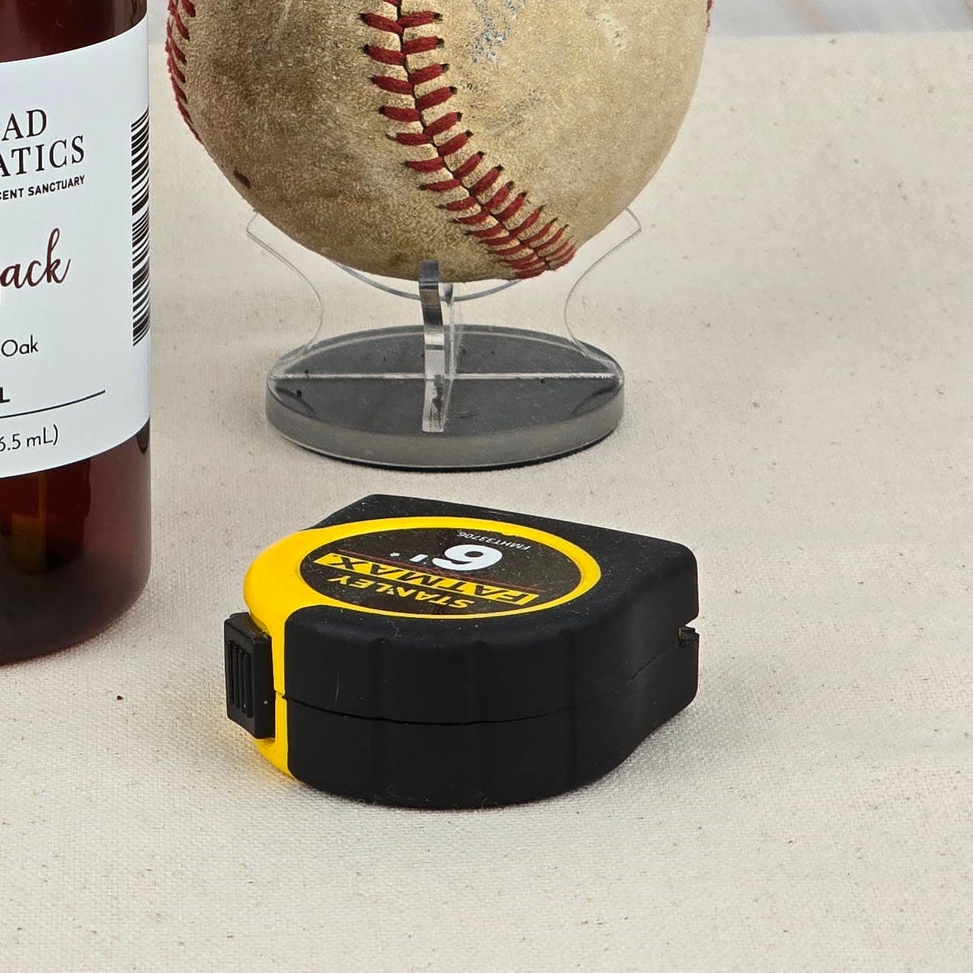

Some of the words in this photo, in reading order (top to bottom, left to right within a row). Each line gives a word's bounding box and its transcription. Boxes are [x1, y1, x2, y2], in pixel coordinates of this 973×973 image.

[27, 174, 85, 197] SANCTUARY
[0, 334, 39, 358] Oak
[26, 424, 59, 448] mL)
[457, 530, 531, 551] FMHT33706
[330, 554, 529, 601] FATMAX
[327, 575, 475, 609] STANLEY
